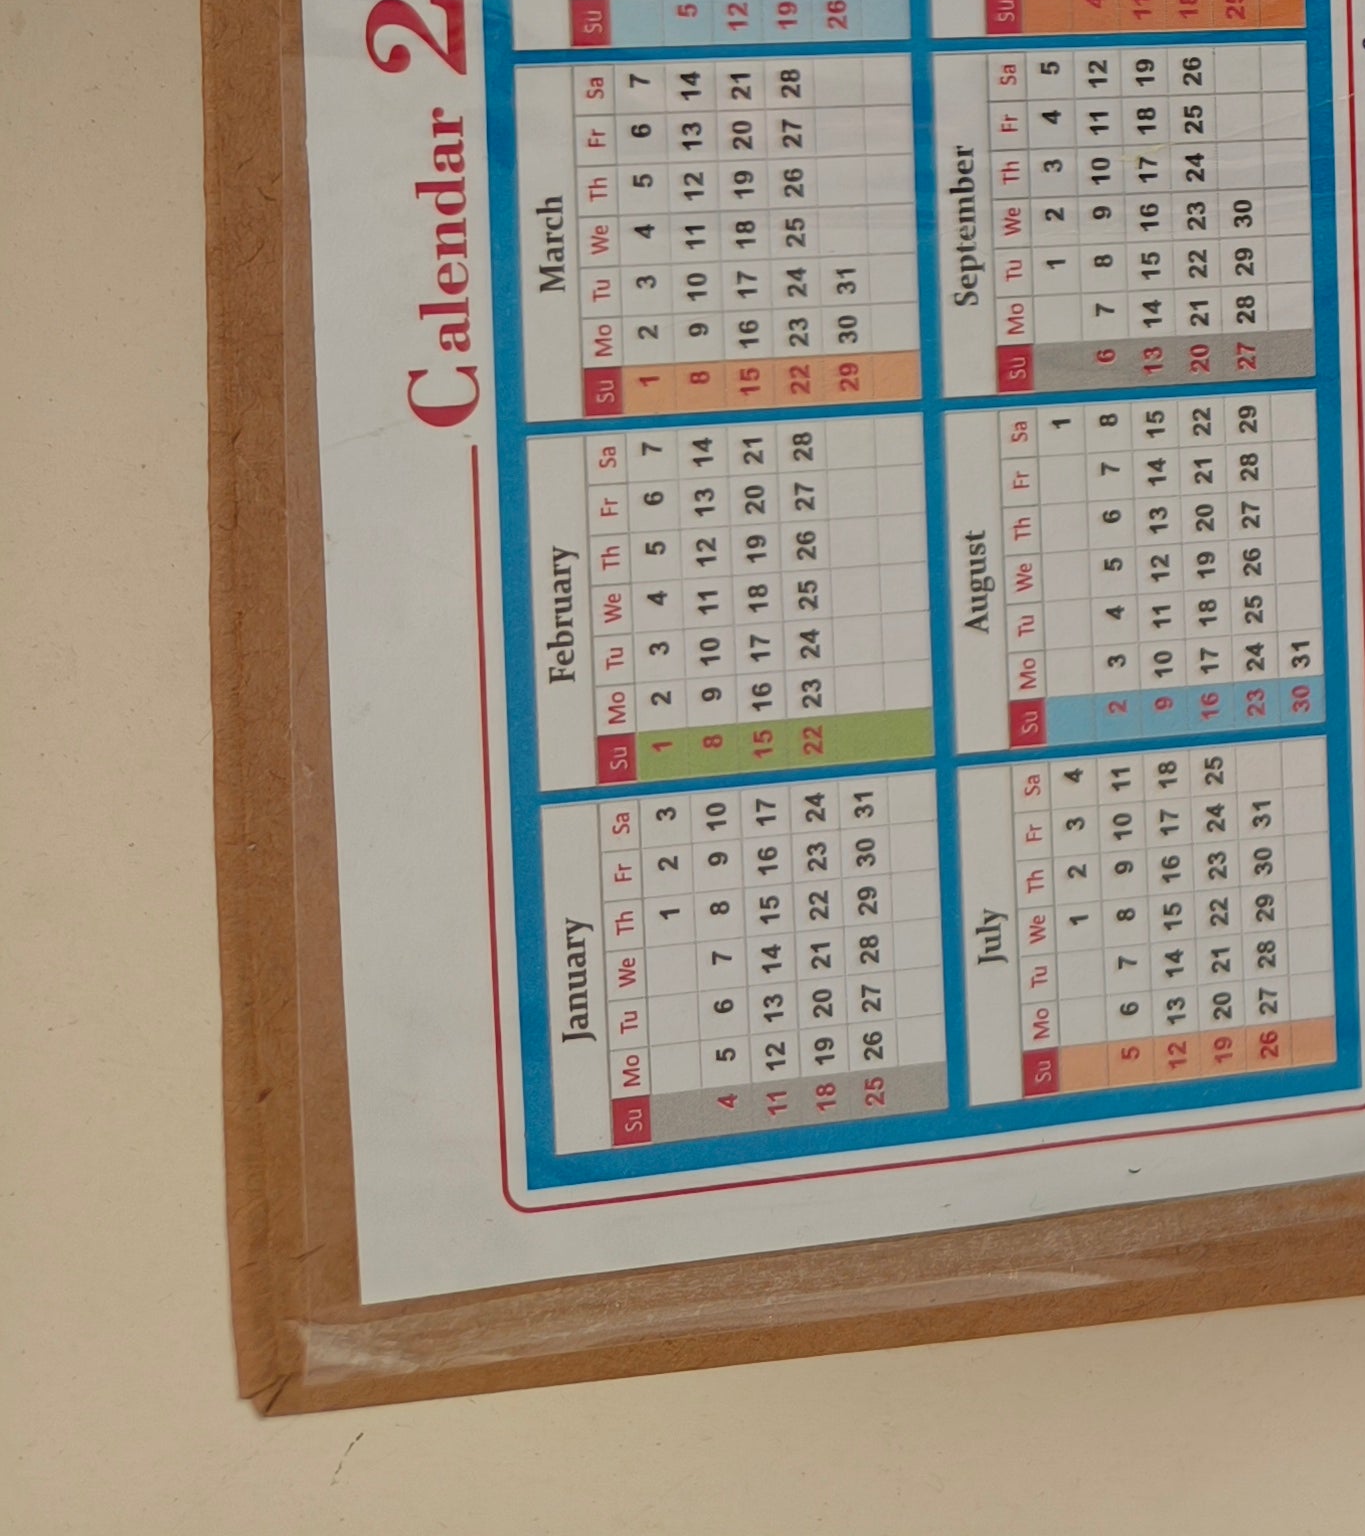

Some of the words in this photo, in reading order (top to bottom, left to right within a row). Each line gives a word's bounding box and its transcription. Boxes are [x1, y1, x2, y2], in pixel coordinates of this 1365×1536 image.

[676, 3, 698, 18] 5
[996, 0, 1016, 22] Su
[779, 69, 801, 98] 28
[1135, 58, 1155, 87] 19
[585, 76, 605, 99] Sa
[781, 118, 803, 148] 27
[1136, 107, 1157, 135] 18
[587, 128, 606, 148] Fr
[783, 168, 805, 198] 26
[1137, 156, 1158, 184] 17
[587, 177, 608, 202] Th
[948, 145, 985, 307] September
[1139, 203, 1160, 232] 16
[535, 196, 566, 293] March
[590, 225, 609, 255] We
[784, 217, 806, 248] 25
[407, 106, 480, 428] Calendar
[1140, 251, 1161, 280] 15
[592, 279, 611, 303] Tu
[785, 267, 808, 298] 24
[1142, 299, 1163, 329] 14
[594, 324, 613, 357] Mo
[787, 317, 809, 347] 23
[1142, 346, 1164, 375] 13
[595, 379, 615, 403] Su
[788, 364, 811, 395] 22
[1010, 420, 1029, 443] Sa
[1237, 405, 1258, 434] 29
[641, 441, 663, 457] 7
[1012, 470, 1030, 490] Fr
[1239, 452, 1259, 482] 28
[643, 491, 664, 506] 6
[1012, 517, 1032, 541] Th
[1240, 500, 1261, 529] 27
[644, 540, 666, 556] 5
[1242, 547, 1262, 577] 26
[963, 530, 996, 634] August
[1015, 563, 1034, 593] We
[646, 590, 668, 607] 4
[1243, 595, 1264, 625] 25
[546, 546, 580, 685] February
[1017, 614, 1035, 638] Tu
[648, 641, 670, 656] 3
[1245, 642, 1265, 672] 24
[1019, 657, 1037, 690] Mo
[650, 690, 672, 706] 2
[1245, 688, 1266, 717] 23
[1020, 711, 1039, 735] Su
[650, 741, 673, 753] 1
[1110, 767, 1131, 792] 11
[611, 812, 631, 835] Sa
[755, 798, 777, 827] 17
[1112, 813, 1133, 841] 10
[613, 863, 633, 883] Fr
[757, 846, 779, 876] 16
[1113, 860, 1134, 875] 9
[614, 910, 635, 937] Th
[759, 895, 781, 925] 15
[1115, 907, 1136, 922] 8
[975, 908, 1009, 965] July
[618, 957, 637, 988] We
[760, 943, 782, 974] 14
[1117, 955, 1138, 971] 7
[561, 917, 597, 1044] January
[619, 1010, 639, 1035] Tu
[762, 993, 784, 1023] 13
[1119, 1001, 1140, 1017] 6
[764, 1041, 786, 1072] 12
[1120, 1045, 1141, 1061] 5
[622, 1054, 641, 1088] Mo
[765, 1090, 788, 1116] 11
[624, 1108, 643, 1133] Su
